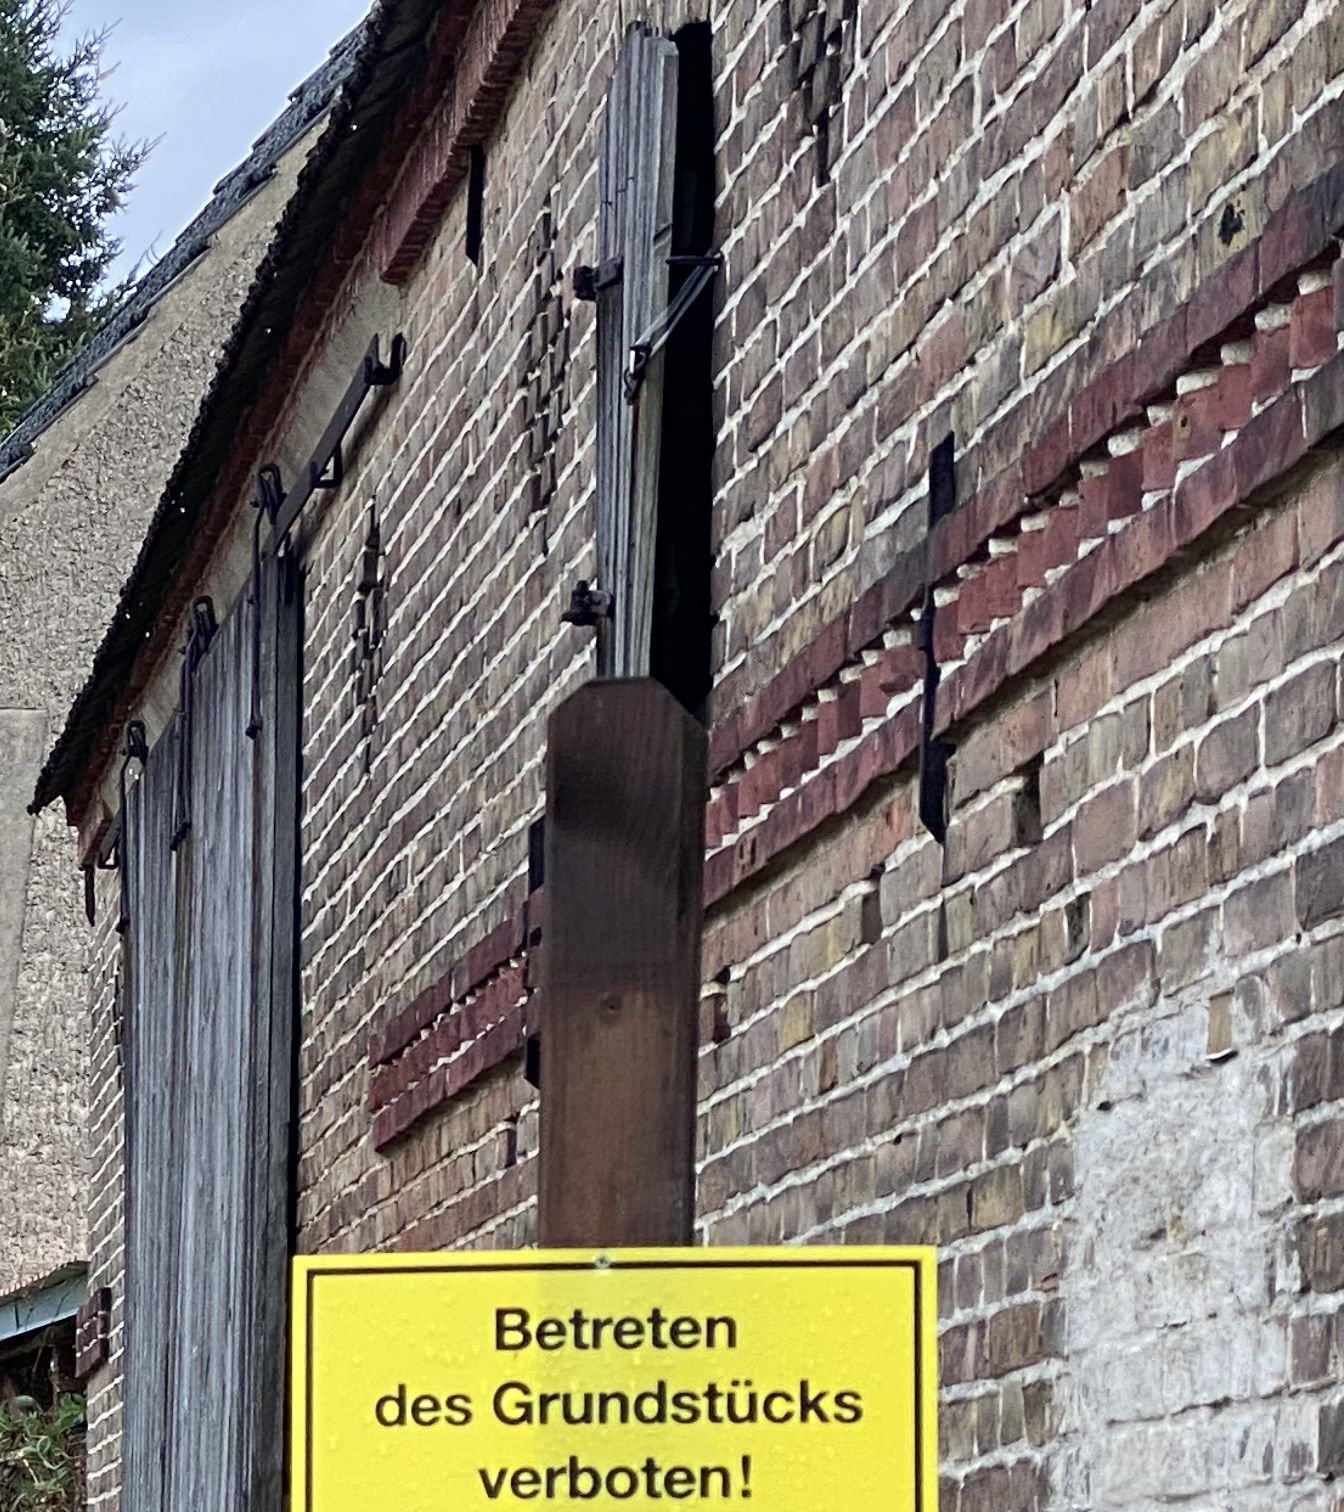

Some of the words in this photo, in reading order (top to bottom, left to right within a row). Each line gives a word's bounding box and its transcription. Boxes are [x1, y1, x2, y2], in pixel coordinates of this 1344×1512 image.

[495, 1307, 737, 1351] Betreten
[375, 1383, 473, 1427] des
[492, 1379, 863, 1426] Grundstücks
[478, 1454, 752, 1500] verboten!
